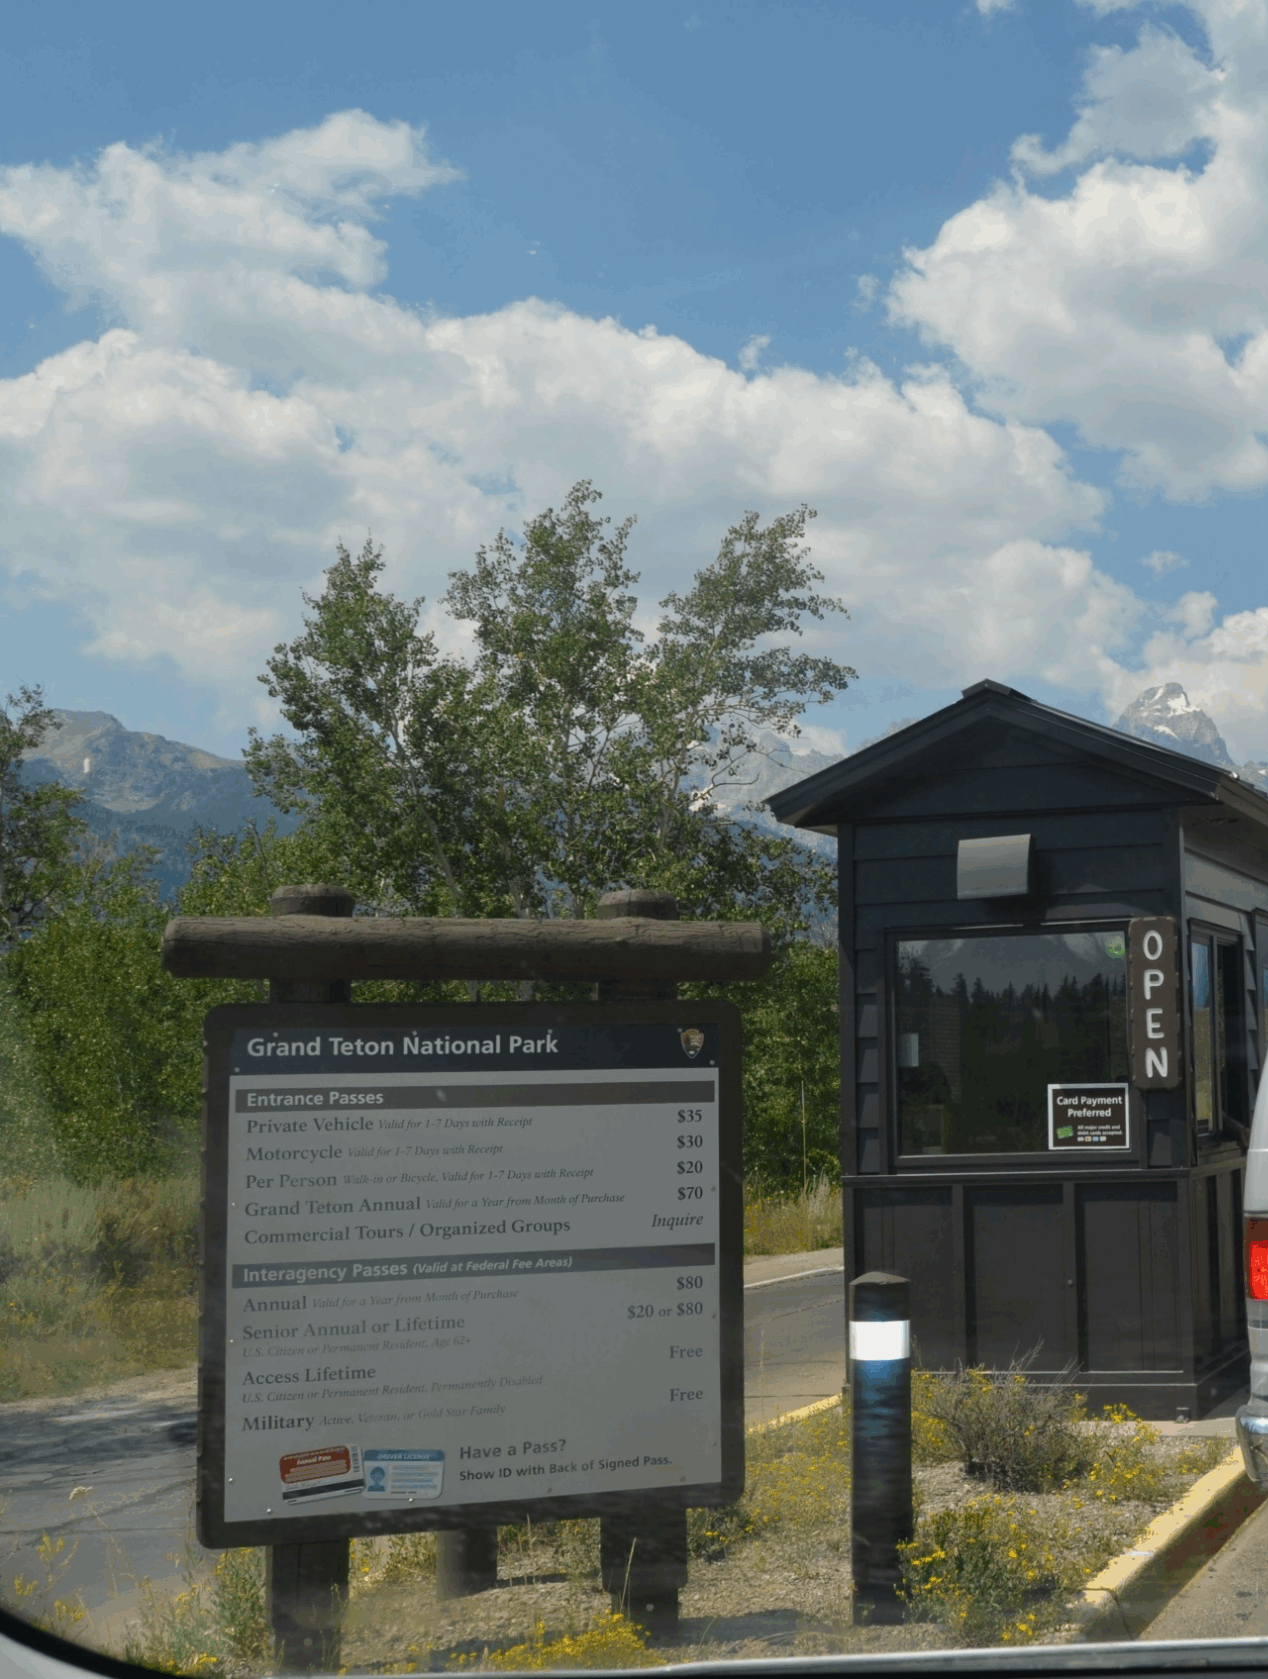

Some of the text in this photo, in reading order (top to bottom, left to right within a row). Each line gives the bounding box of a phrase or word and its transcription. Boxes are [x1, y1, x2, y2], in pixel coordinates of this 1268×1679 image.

[1142, 929, 1168, 1078] OPEN
[247, 1034, 559, 1057] Grand Teton National Park
[246, 1091, 384, 1107] Entrance Passes
[1056, 1096, 1122, 1107] Card Payment
[677, 1109, 702, 1123] $35
[1067, 1107, 1111, 1117] Preferred
[246, 1116, 533, 1133] Private Vehicle Valid for 1-7 Days with Receipt
[677, 1134, 703, 1149] $30
[245, 1144, 503, 1163] Motorcycle Valid for 1-7 Days with Receipt
[677, 1160, 703, 1174] $20
[245, 1168, 594, 1189] Per Person Walk-in or Bicycle, Valid for 1-7 Days with Receipt
[677, 1186, 703, 1200] $70
[244, 1193, 626, 1216] Grand Teton Annual Valid for a Year from Month of Purchase
[244, 1219, 571, 1244] Commercial Tours / Organized Groups
[651, 1214, 704, 1230] Inquire
[243, 1256, 573, 1284] Interagency Passes (Valid at Federal Fee Areas)
[676, 1276, 703, 1290] $80
[242, 1289, 519, 1312] Annual Valid for a Year from Month of Purchase
[627, 1302, 703, 1320] $20 or $80
[242, 1316, 466, 1340] Senior Annual or Lifetime
[242, 1347, 265, 1358] U.S.
[267, 1344, 304, 1356] Citizen
[307, 1346, 320, 1355] or
[322, 1342, 380, 1354] Permanent
[382, 1338, 429, 1351] Resident,
[431, 1338, 450, 1350] Age
[669, 1345, 704, 1359] Free
[242, 1366, 376, 1386] Access Lifetime
[242, 1375, 543, 1404] U.S. Citizen or Permanent Resident, Permanently Disabled
[670, 1388, 704, 1402] Free
[242, 1414, 315, 1432] Military
[403, 1412, 416, 1420] or
[418, 1408, 443, 1420] Gold
[445, 1406, 468, 1418] Star
[470, 1404, 506, 1416] Family
[460, 1438, 566, 1460] Have a Pass?
[460, 1456, 672, 1482] Show ID with Back of Signed Pass.
